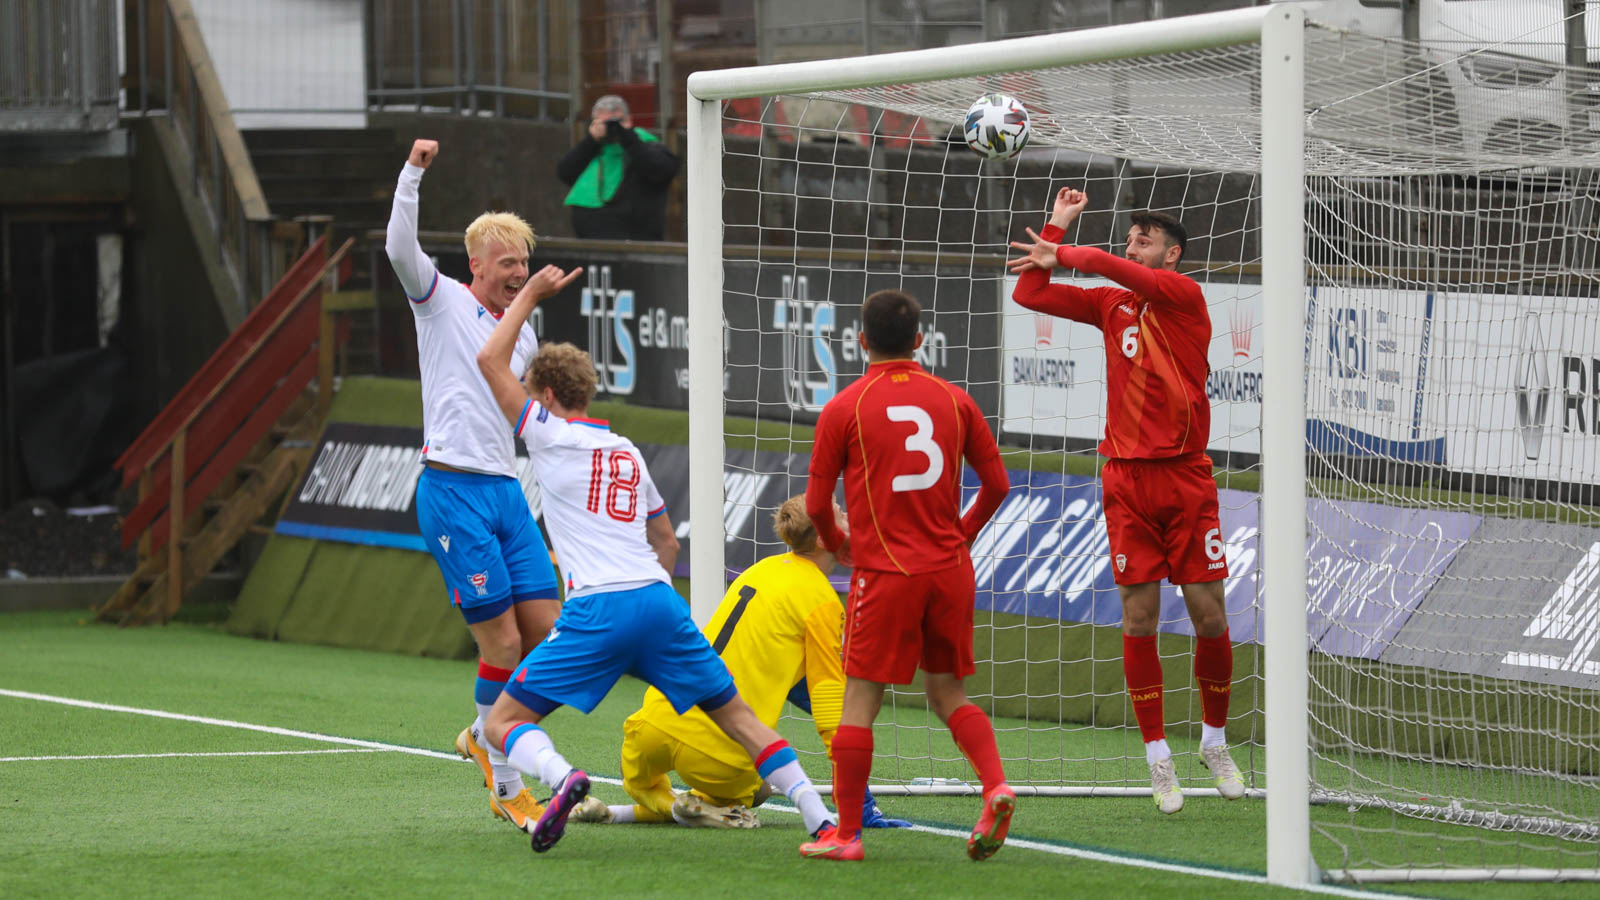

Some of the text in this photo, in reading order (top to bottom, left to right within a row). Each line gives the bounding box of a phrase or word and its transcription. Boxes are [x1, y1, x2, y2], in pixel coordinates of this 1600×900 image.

[1122, 326, 1139, 358] 6
[1328, 308, 1366, 379] KBI
[1013, 356, 1075, 389] BAKKAFROST
[886, 405, 944, 492] 3
[587, 449, 640, 522] 18
[1205, 528, 1223, 560] 6
[1208, 562, 1225, 570] JAKO
[712, 585, 757, 656] 1
[1132, 692, 1159, 701] JAKO
